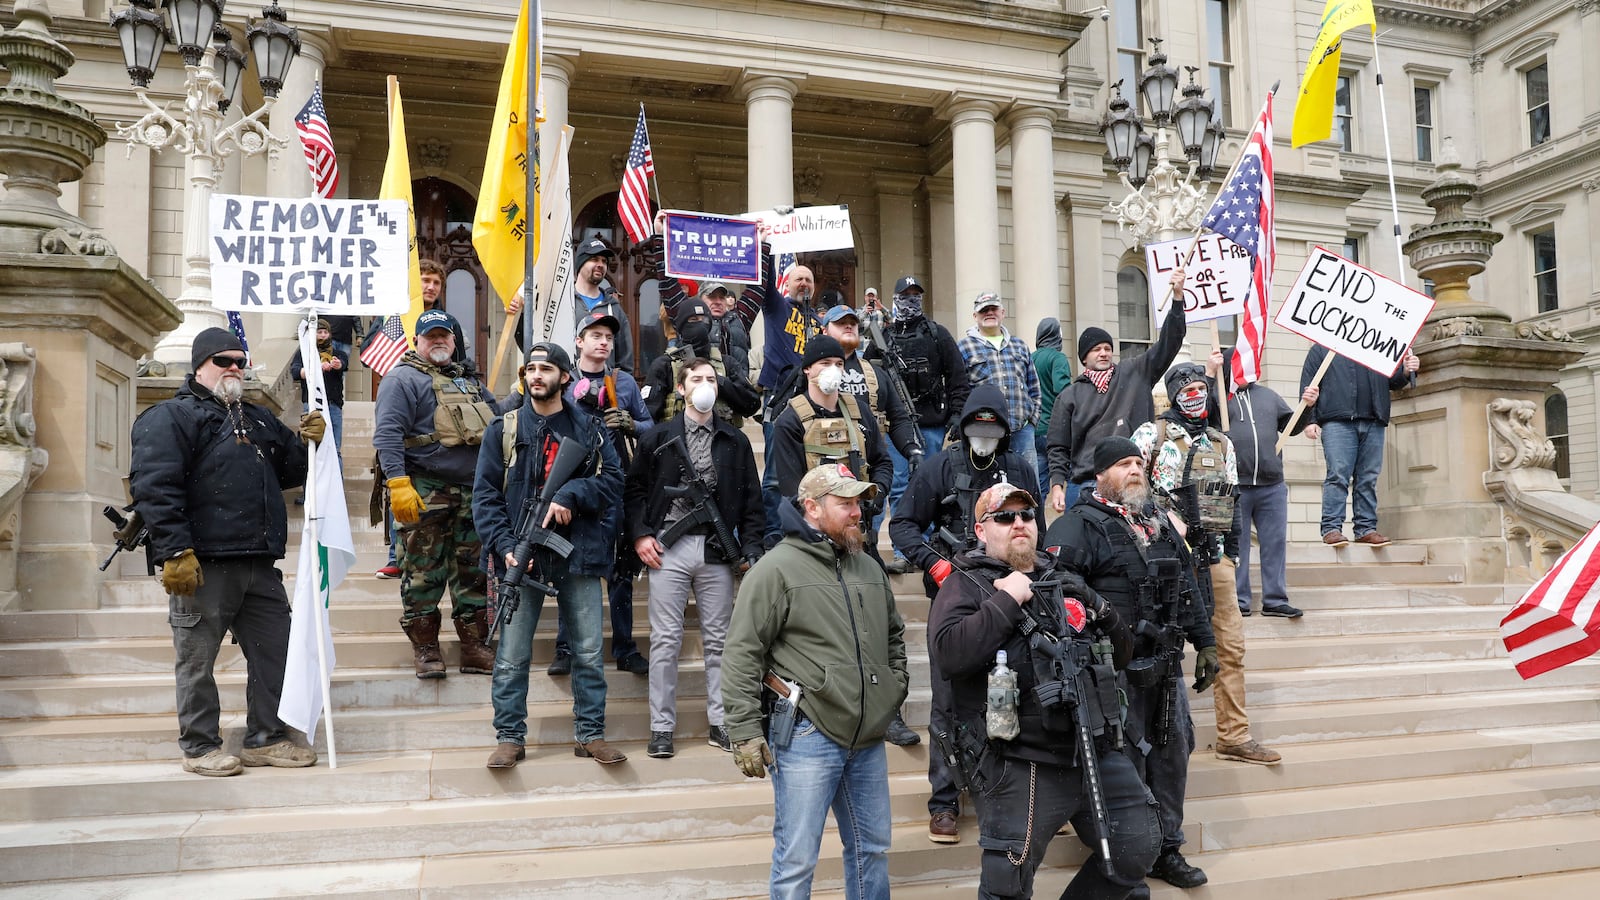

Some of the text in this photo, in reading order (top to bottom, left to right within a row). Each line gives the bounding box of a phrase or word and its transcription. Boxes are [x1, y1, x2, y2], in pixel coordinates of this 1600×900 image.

[223, 199, 397, 235] REMOVE THE
[757, 214, 848, 236] ecall Whitmer
[214, 236, 381, 267] WHITMER
[671, 230, 754, 248] TRUMP
[678, 245, 746, 257] PENCE
[240, 270, 375, 305] REGIME
[1183, 281, 1234, 311] DIE
[1306, 254, 1408, 320] END THE
[1291, 291, 1406, 362] LOCKDOWN
[838, 382, 869, 395] Kapp
